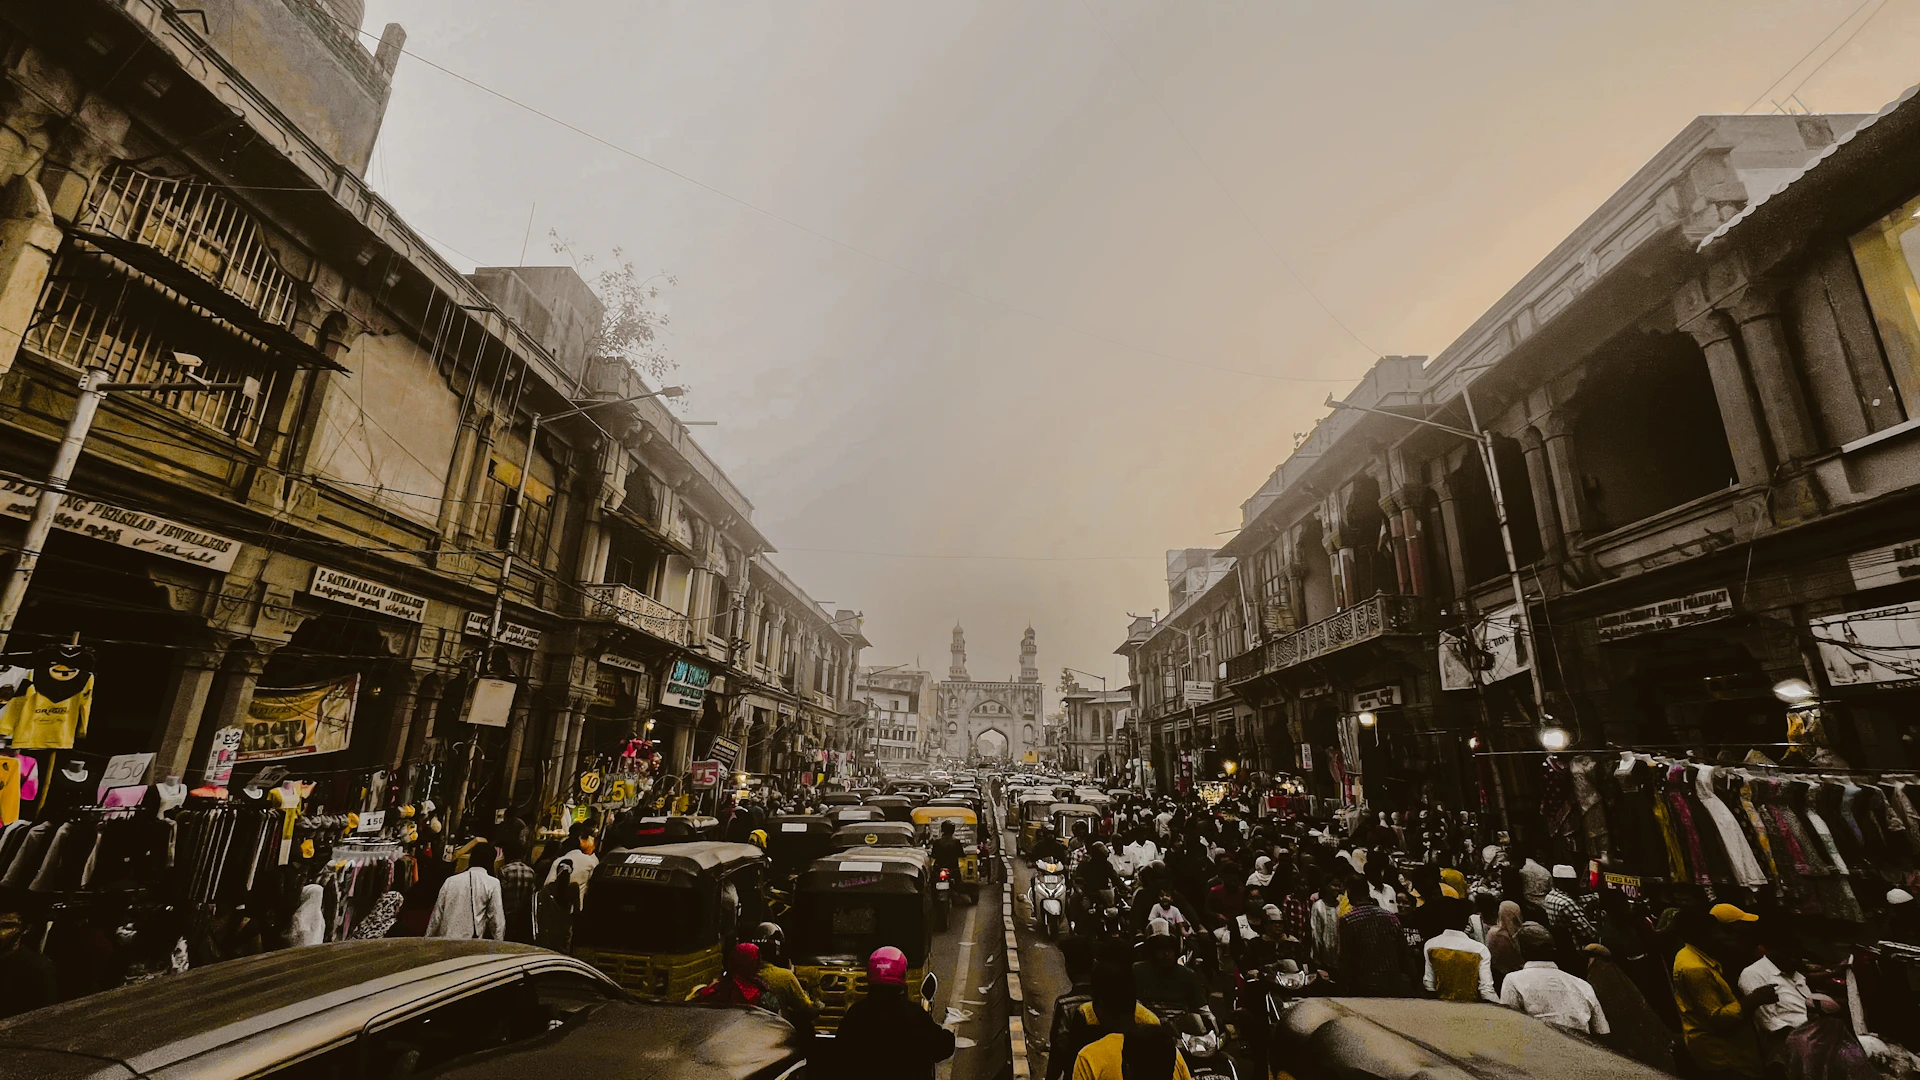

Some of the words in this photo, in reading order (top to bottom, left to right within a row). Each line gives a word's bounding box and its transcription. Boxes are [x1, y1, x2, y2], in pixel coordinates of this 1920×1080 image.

[87, 502, 156, 532] PERSHAD
[156, 523, 233, 553] JEWELLERS
[387, 591, 426, 609] JEWELLERS
[104, 760, 145, 780] 150
[586, 775, 599, 789] 10
[611, 780, 625, 802] 5
[366, 817, 383, 826] 150
